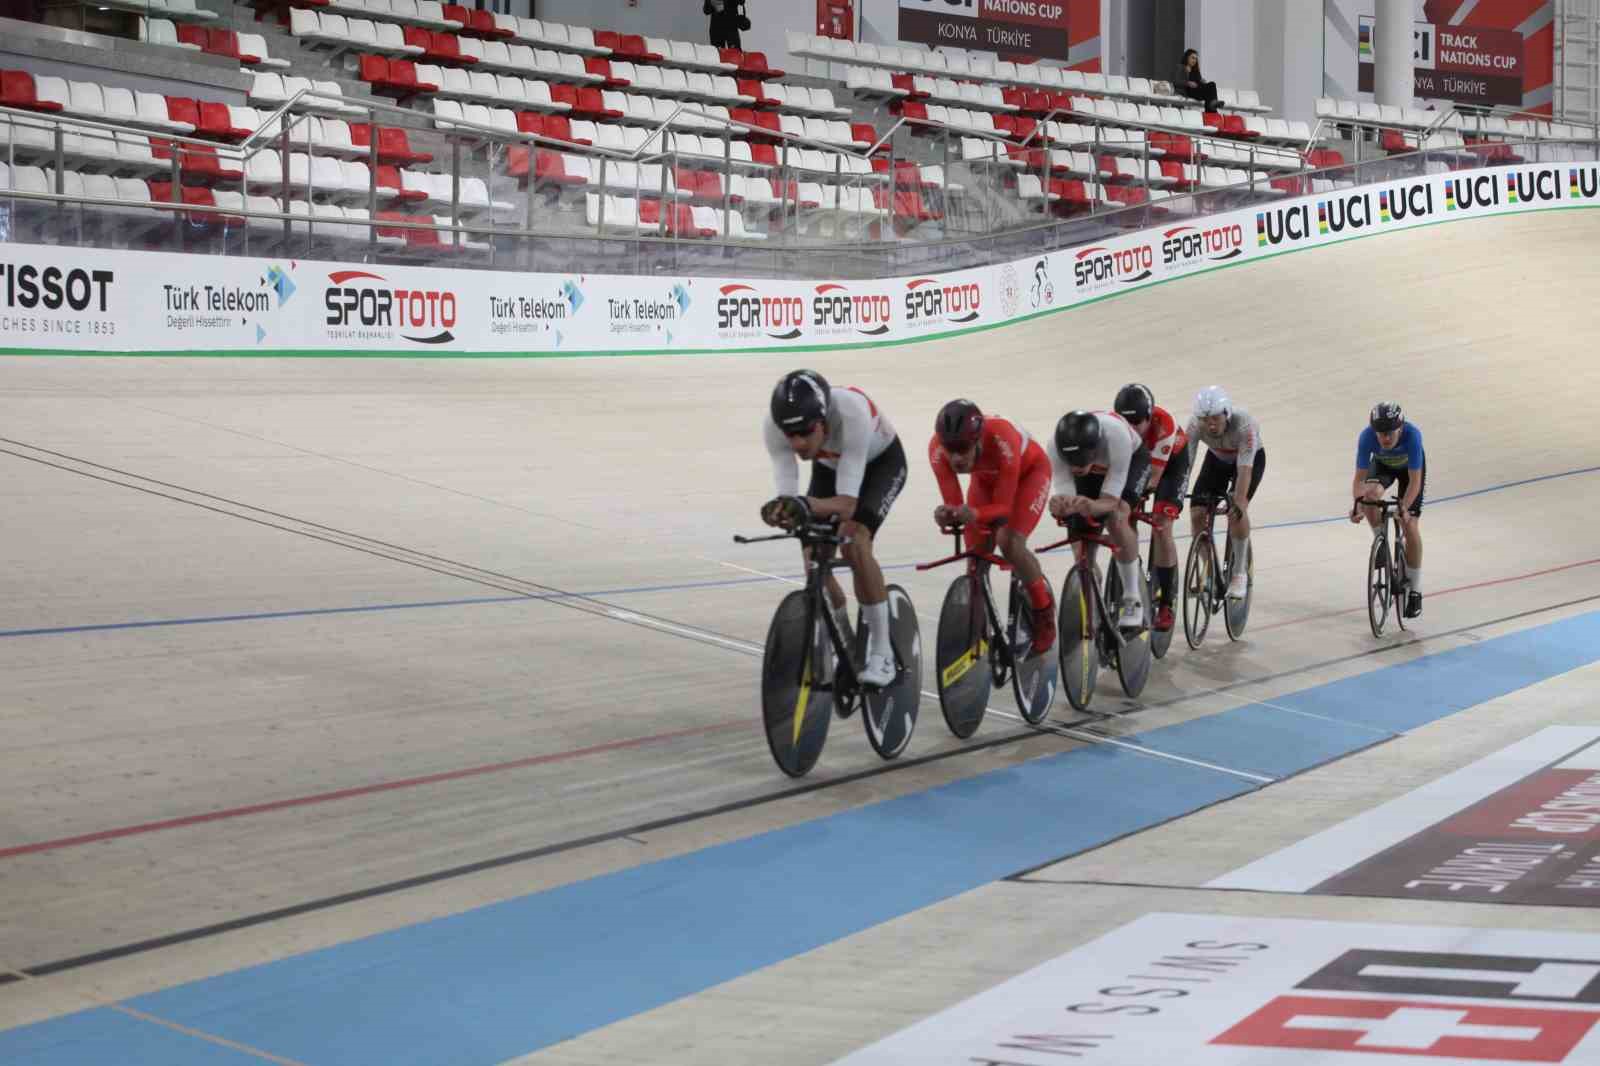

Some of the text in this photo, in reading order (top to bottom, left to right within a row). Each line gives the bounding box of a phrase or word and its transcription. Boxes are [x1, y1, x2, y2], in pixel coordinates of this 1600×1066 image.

[984, 0, 1036, 16] NATIONS
[1039, 5, 1063, 19] CUP
[938, 23, 977, 41] KONYA
[1440, 33, 1478, 49] TRACK
[1440, 50, 1517, 69] NATIONS CUP
[1414, 77, 1434, 91] NYA
[1455, 175, 1499, 209] UCI
[1517, 170, 1561, 202] UCI
[1328, 194, 1371, 232] UCI
[1389, 184, 1432, 220] UCI
[1267, 205, 1309, 244] UCI
[0, 264, 114, 312] ISSOT
[164, 285, 269, 312] Türk Telekom
[490, 296, 565, 319] Türk Telekom
[608, 298, 675, 320] Türk Telekom
[2, 317, 115, 336] CHES SINCE 1853
[1065, 939, 1269, 1016] SWISS
